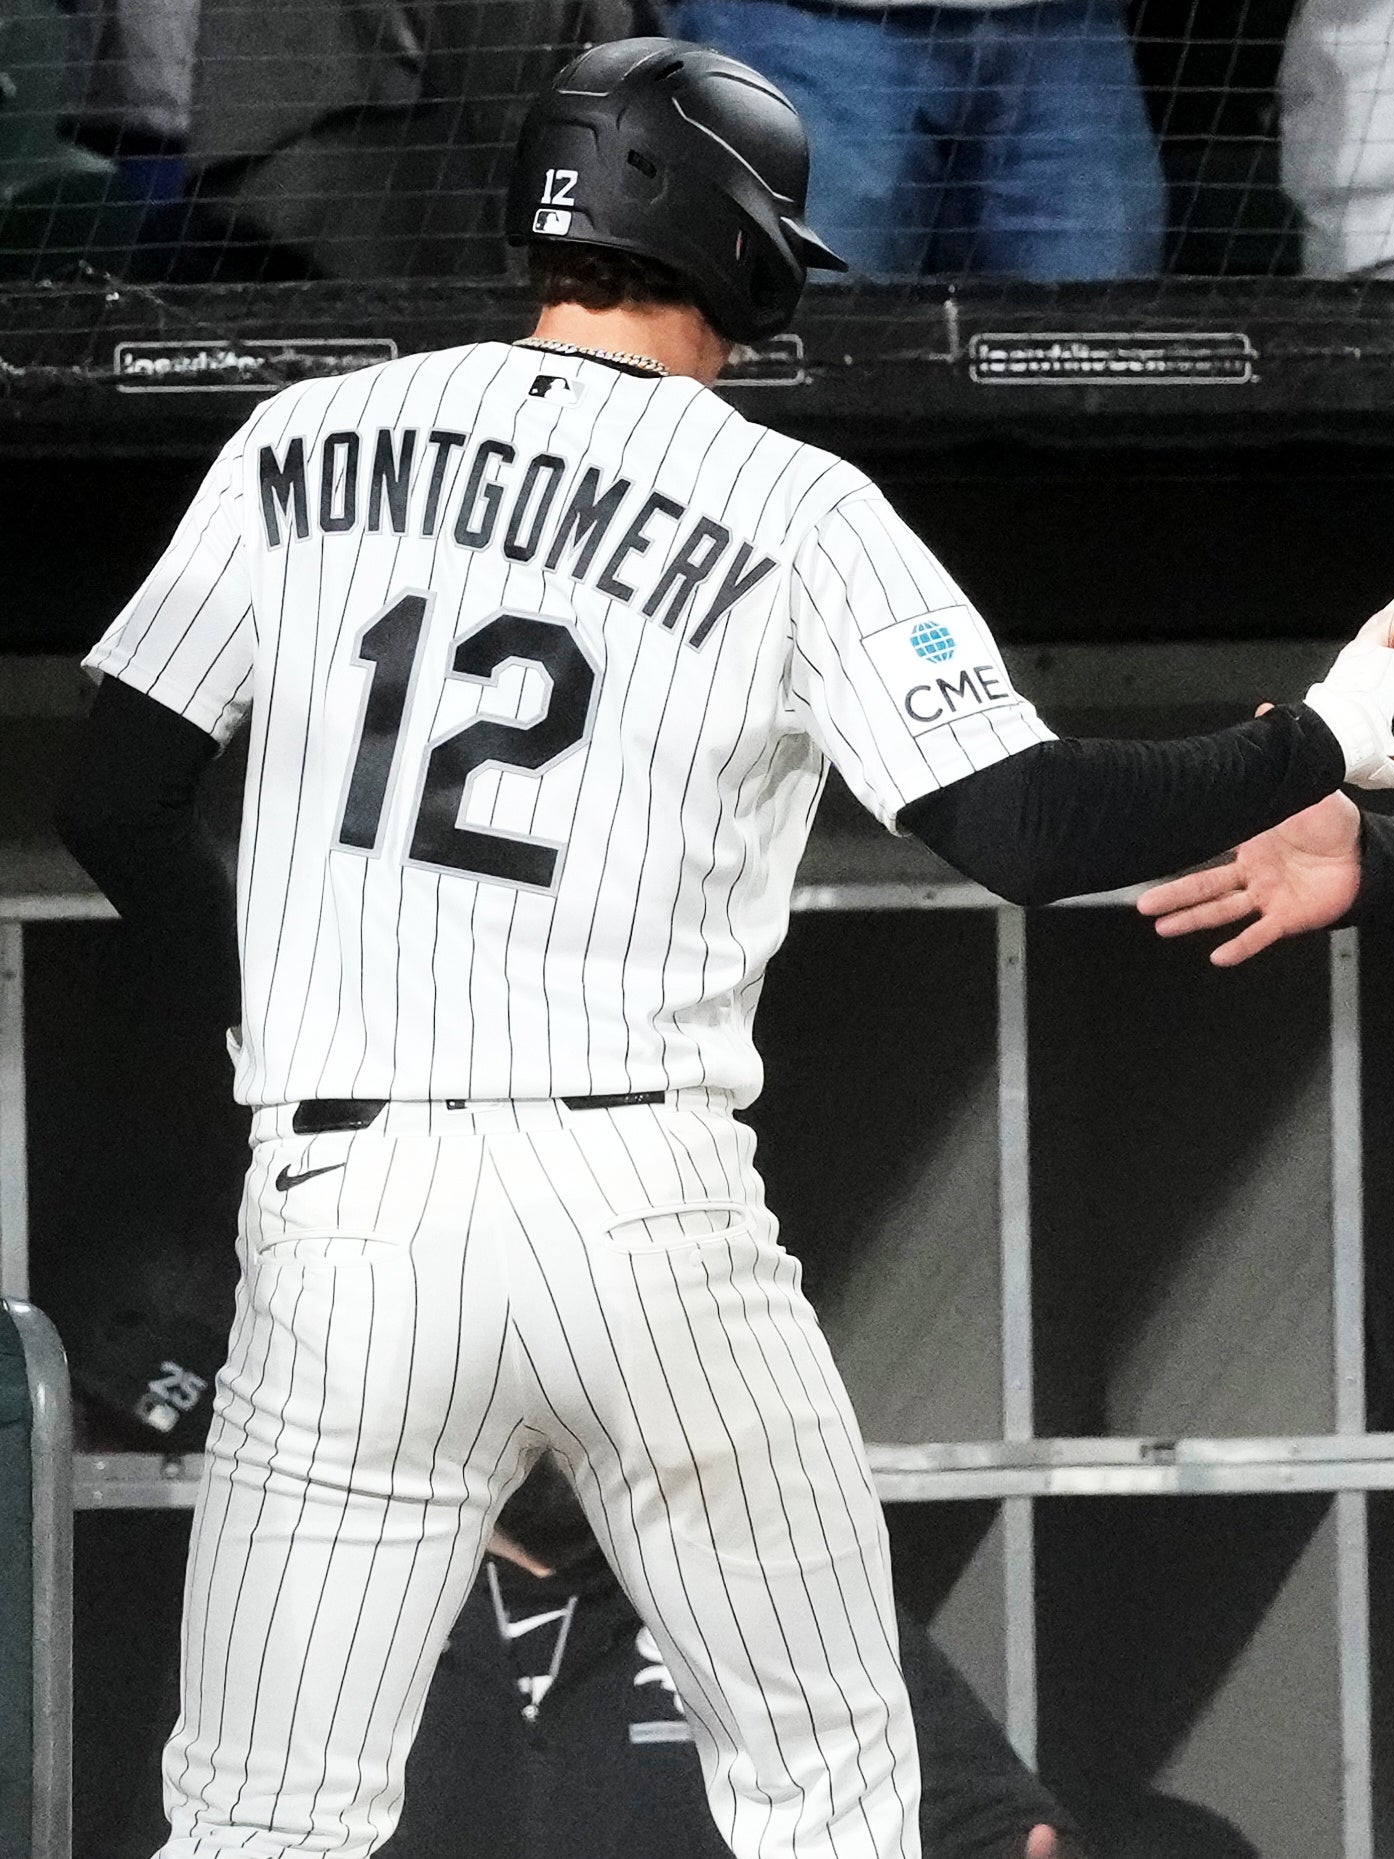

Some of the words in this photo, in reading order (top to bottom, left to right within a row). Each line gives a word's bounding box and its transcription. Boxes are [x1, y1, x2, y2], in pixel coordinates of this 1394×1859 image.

[540, 168, 579, 207] 12
[256, 425, 780, 655] MONTGOMERY
[330, 585, 604, 898] 12
[904, 665, 1010, 723] CME
